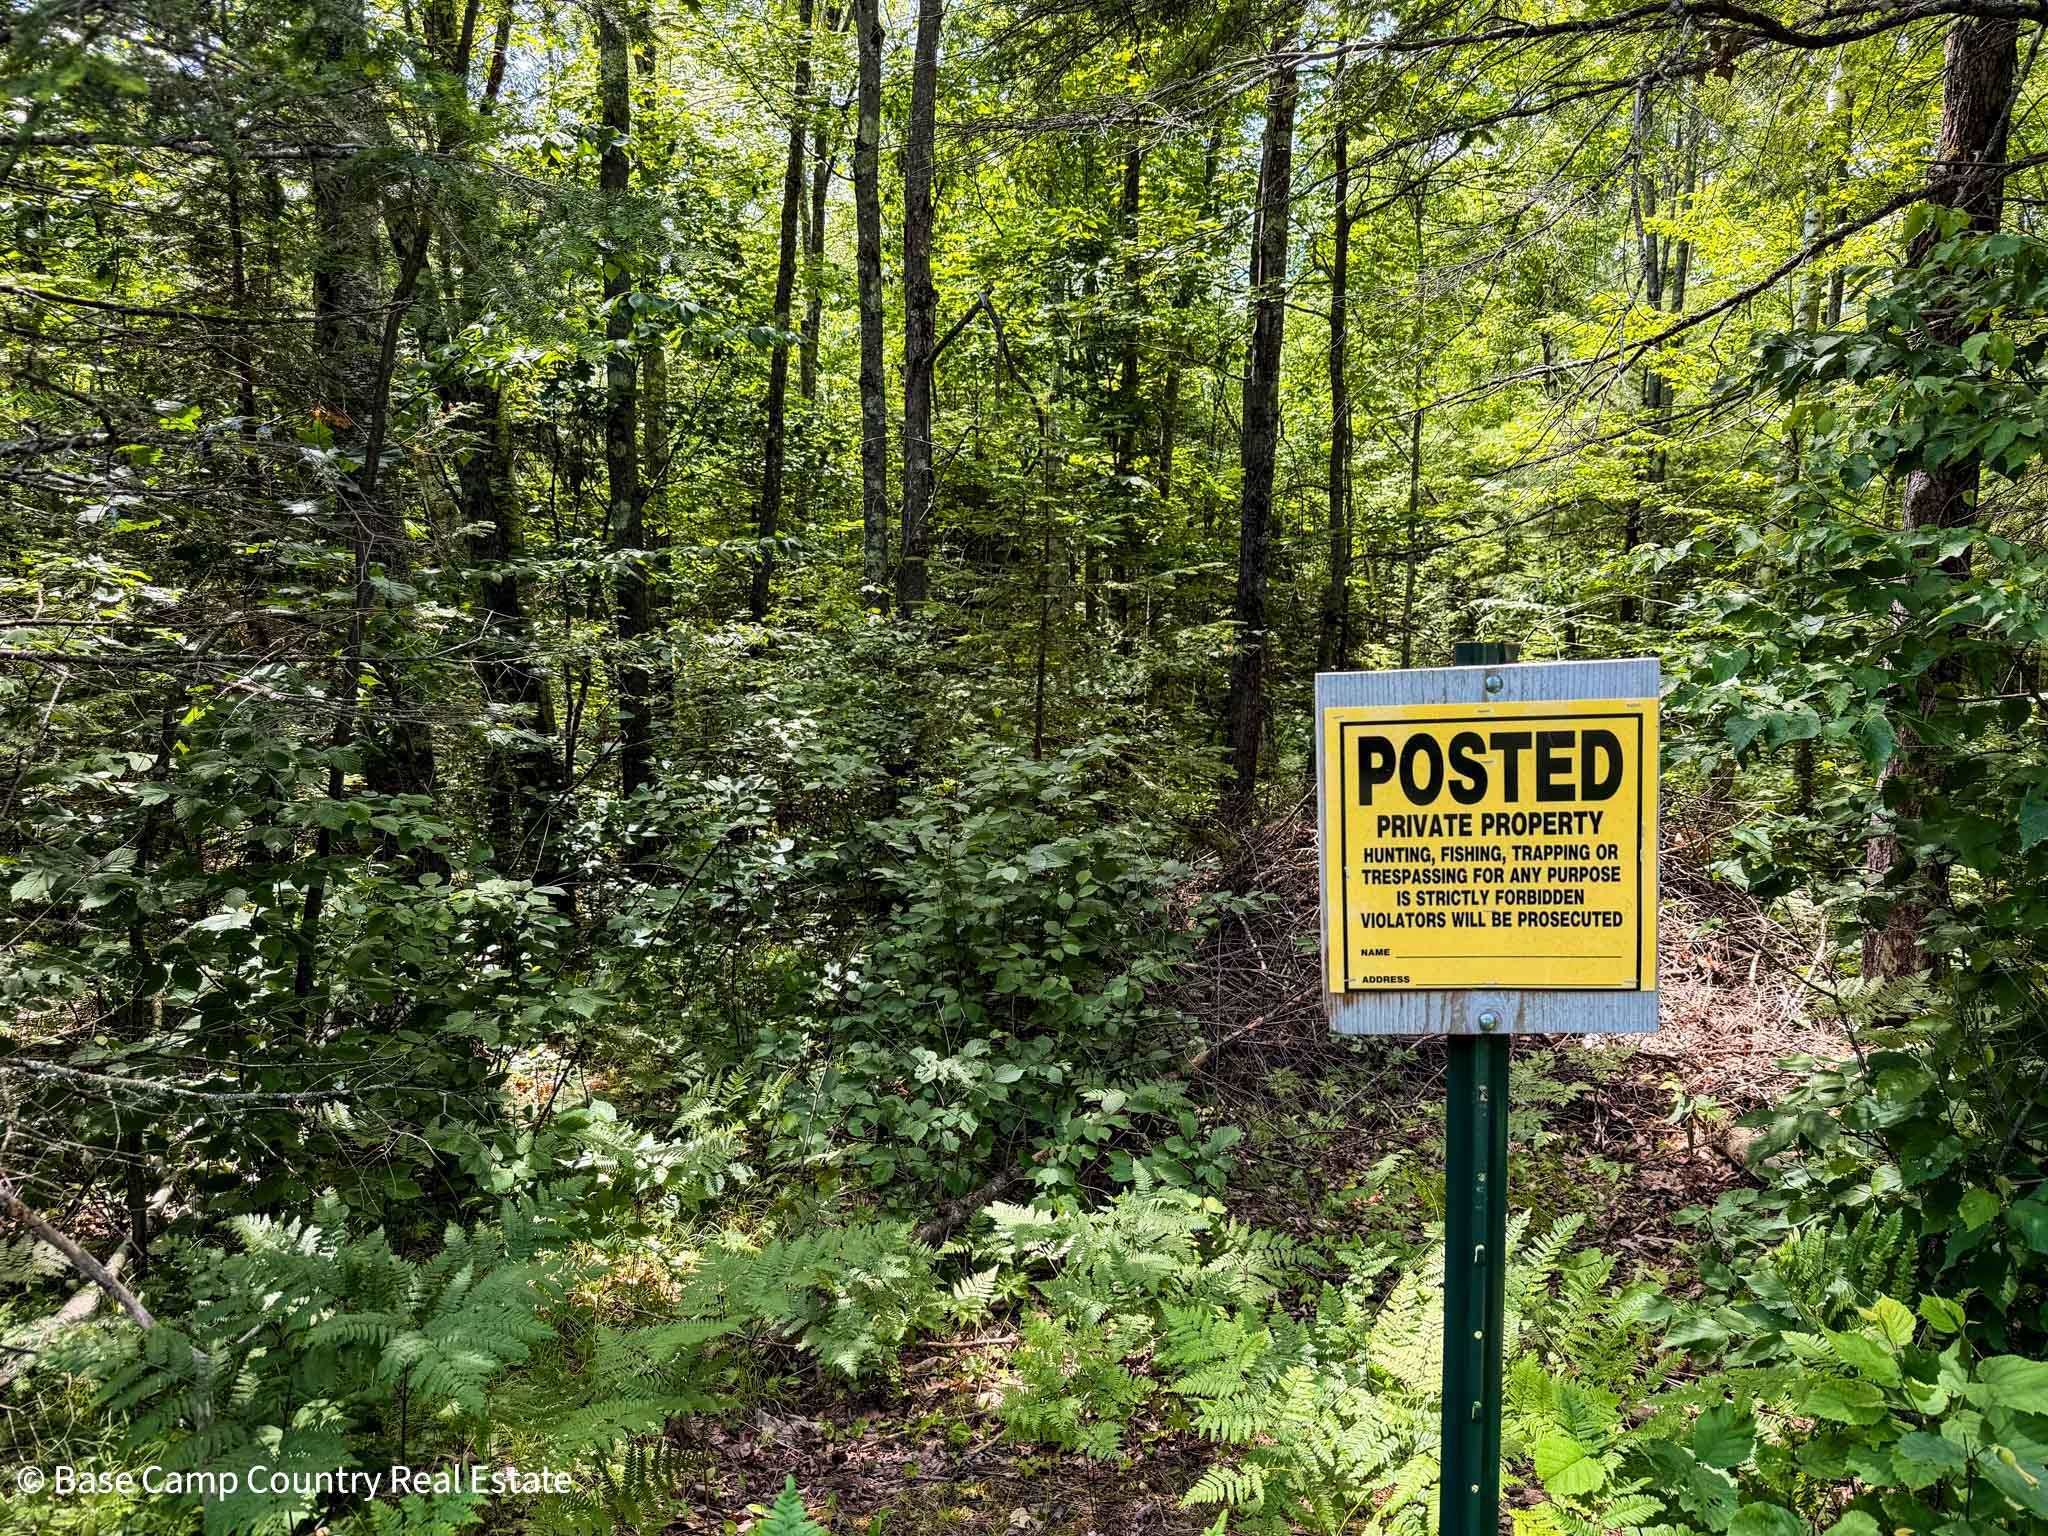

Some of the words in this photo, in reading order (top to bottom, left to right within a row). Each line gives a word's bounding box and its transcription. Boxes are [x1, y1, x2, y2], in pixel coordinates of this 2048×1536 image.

[1358, 729, 1623, 806] POSTED
[1377, 813, 1472, 838] PRIVATE
[1481, 811, 1604, 836] PROPERTY
[1364, 847, 1435, 865] HUNTING,
[1441, 845, 1506, 864] FISHING,
[1512, 845, 1590, 860] TRAPPING
[1596, 844, 1618, 860] OR
[1362, 868, 1468, 885] TRESPASSING
[1473, 868, 1505, 883] FOR
[1509, 867, 1540, 883] ANY
[1547, 866, 1621, 882] PURPOSE
[1397, 891, 1411, 906] IS
[1416, 890, 1489, 906] STRICTLY
[1495, 889, 1584, 905] FORBIDDEN
[1361, 912, 1446, 928] VIOLATORS
[1452, 912, 1486, 927] WILL
[1492, 912, 1512, 927] BE
[1518, 911, 1623, 927] PROSECUTED
[1361, 948, 1390, 956] NAME
